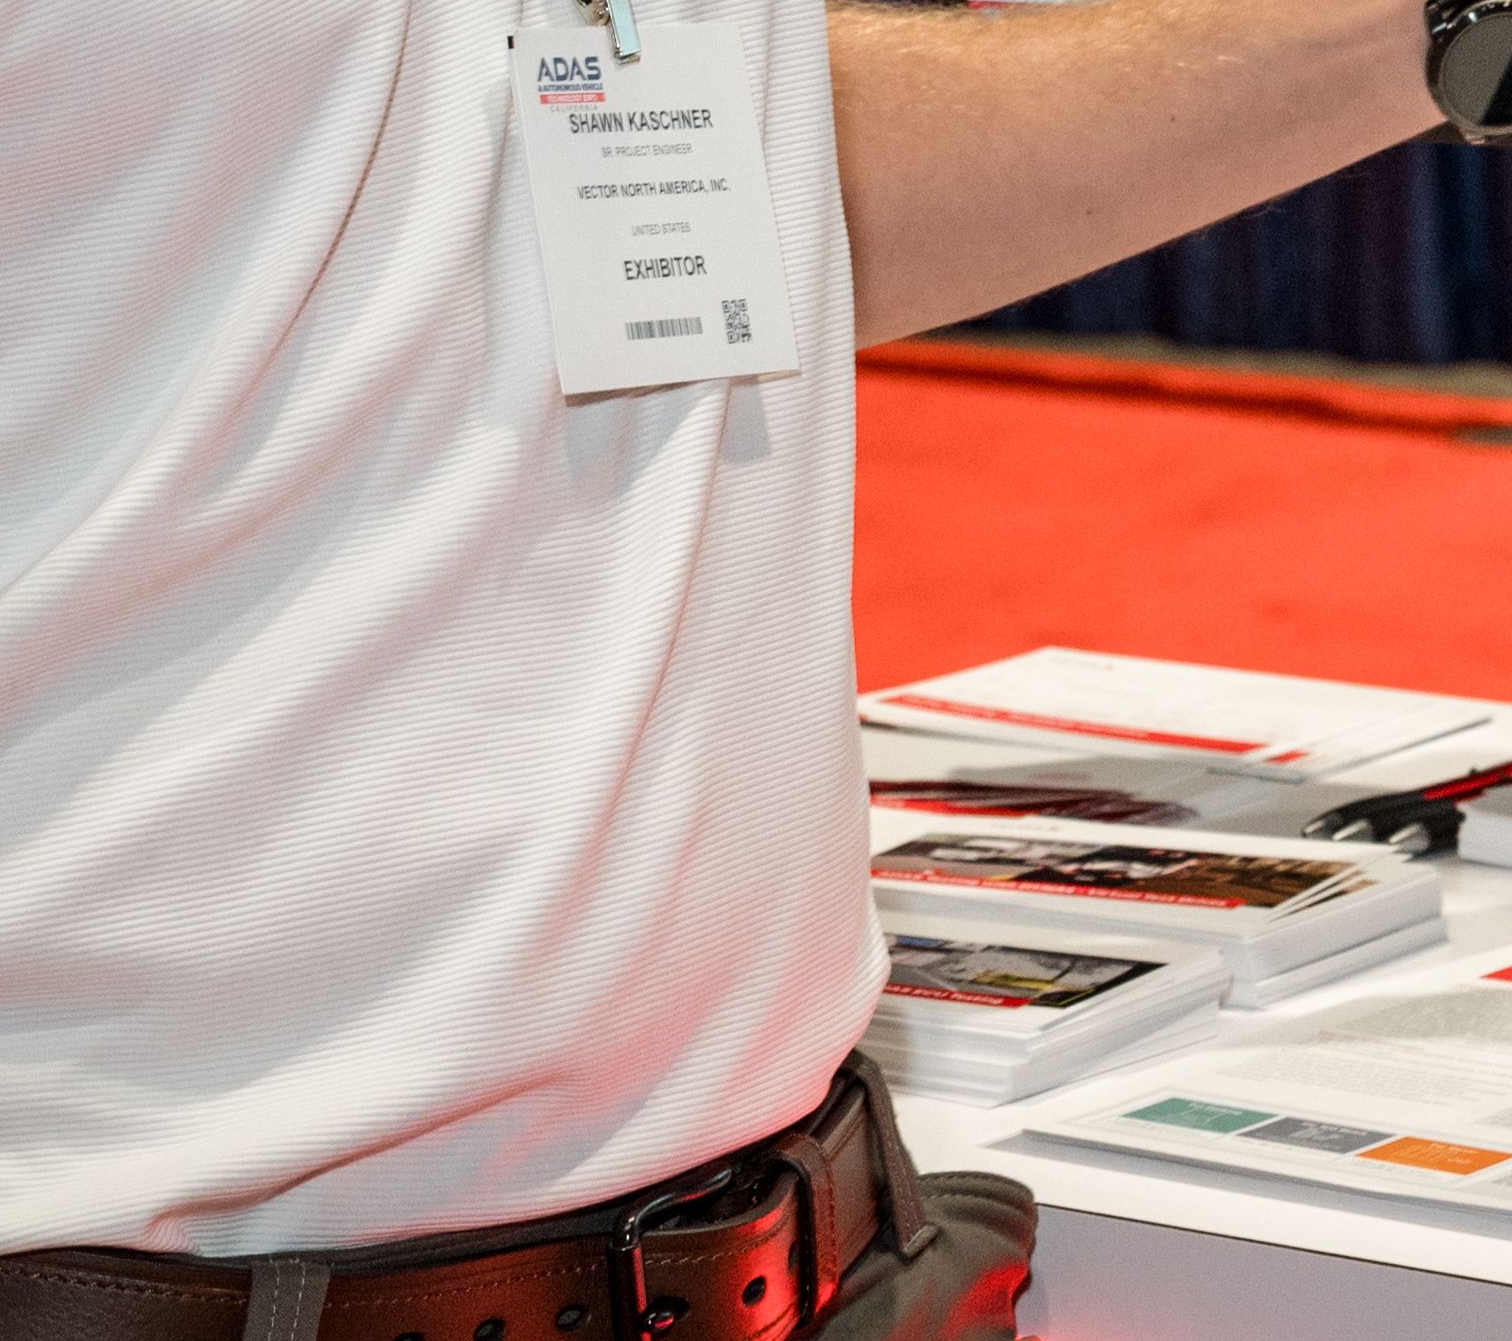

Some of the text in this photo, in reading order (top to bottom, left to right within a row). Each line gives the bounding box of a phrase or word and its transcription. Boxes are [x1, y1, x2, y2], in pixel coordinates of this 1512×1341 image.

[538, 56, 602, 82] ADAS
[569, 109, 714, 134] SHAWN KASCHNER
[615, 144, 651, 158] PROJECT
[653, 143, 694, 157] ENGINEER
[577, 177, 731, 199] VECTOR NORTH AMERICA, INC.
[631, 221, 692, 237] UNITED STATES
[623, 255, 708, 281] EXHIBITOR
